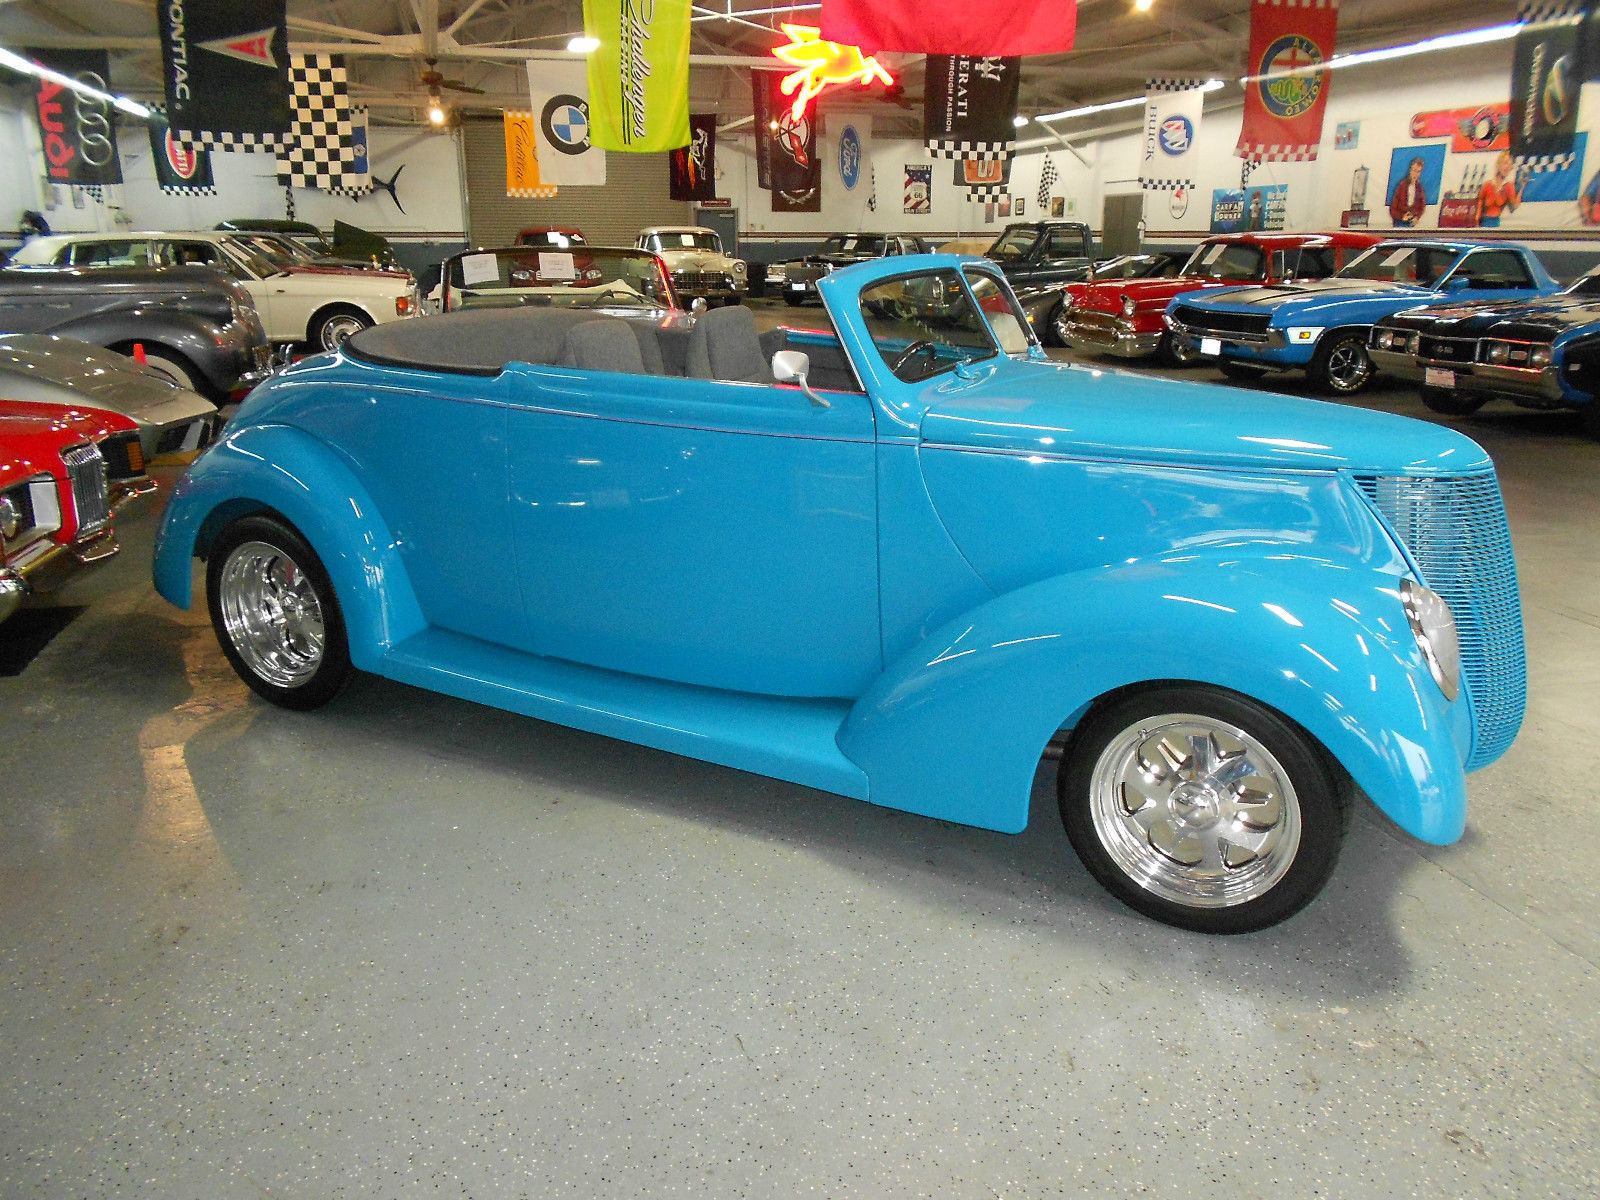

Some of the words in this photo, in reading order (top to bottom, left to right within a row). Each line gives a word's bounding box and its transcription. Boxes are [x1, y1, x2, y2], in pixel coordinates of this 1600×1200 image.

[620, 14, 629, 86] RACING
[947, 54, 956, 95] THROUGH
[945, 96, 953, 132] PASSION
[1145, 106, 1158, 162] BUICK
[842, 138, 858, 176] Ford
